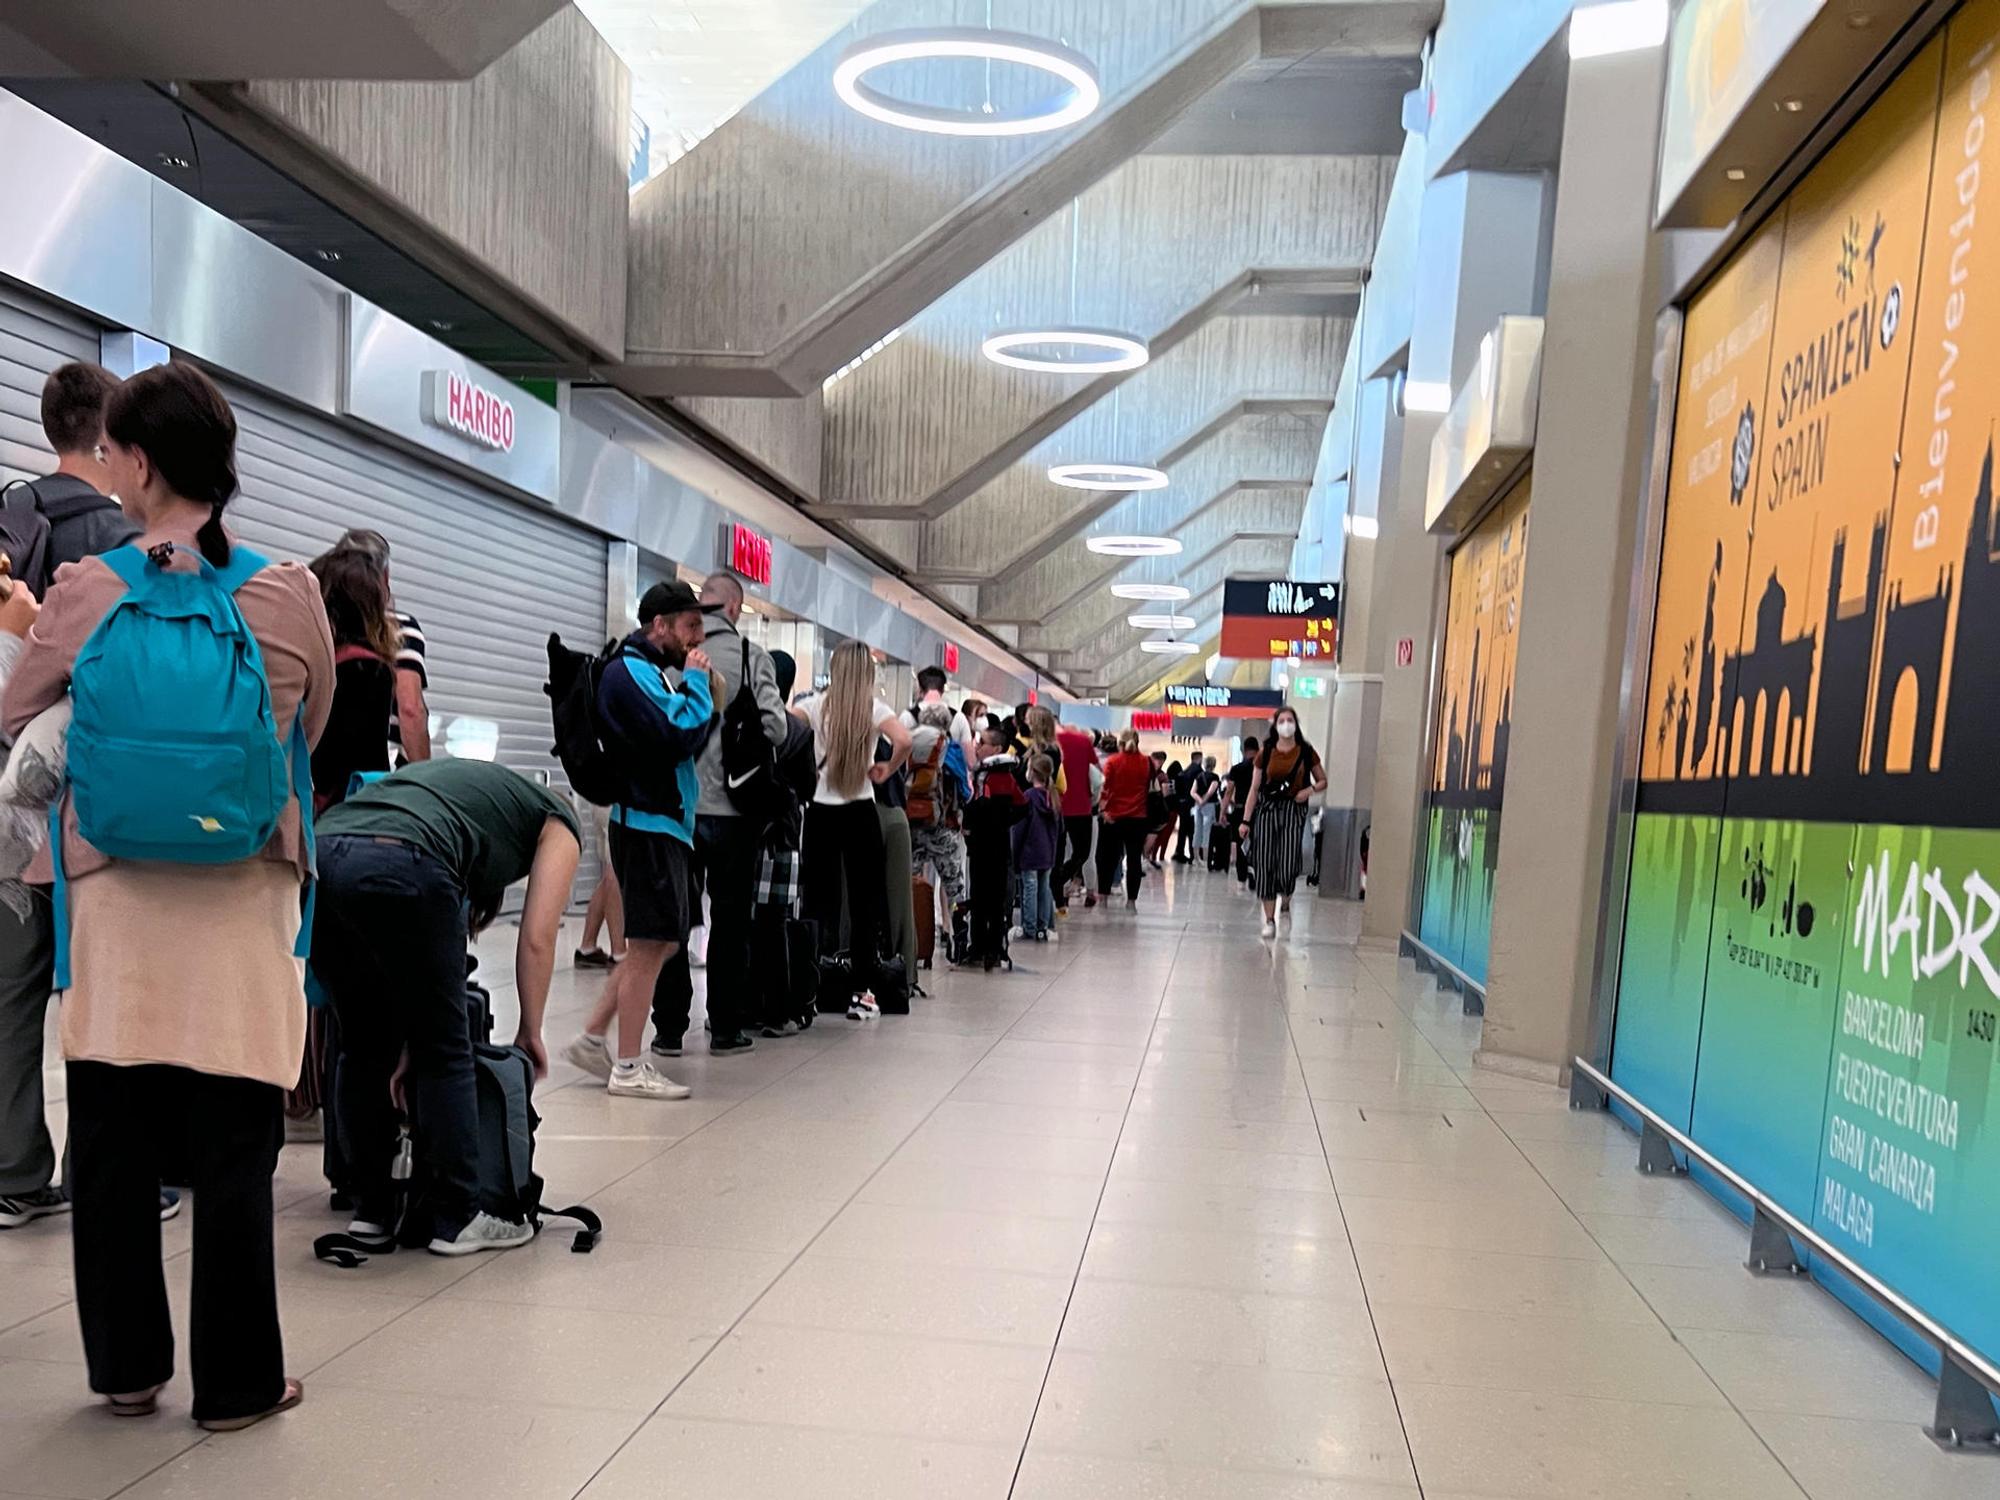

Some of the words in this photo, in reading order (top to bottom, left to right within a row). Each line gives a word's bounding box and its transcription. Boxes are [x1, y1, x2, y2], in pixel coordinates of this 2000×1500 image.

[1777, 296, 1877, 429] SPANIEN
[448, 373, 514, 452] HARIBO
[1768, 412, 1829, 511] SPAIN
[1842, 991, 1925, 1060] BARCELONA
[1836, 1052, 1959, 1151] FUERTEVENTURA
[1822, 1176, 1875, 1248] MALAGA
[1829, 1115, 1866, 1173] GRAN
[1868, 1136, 1936, 1214] CANARIA
